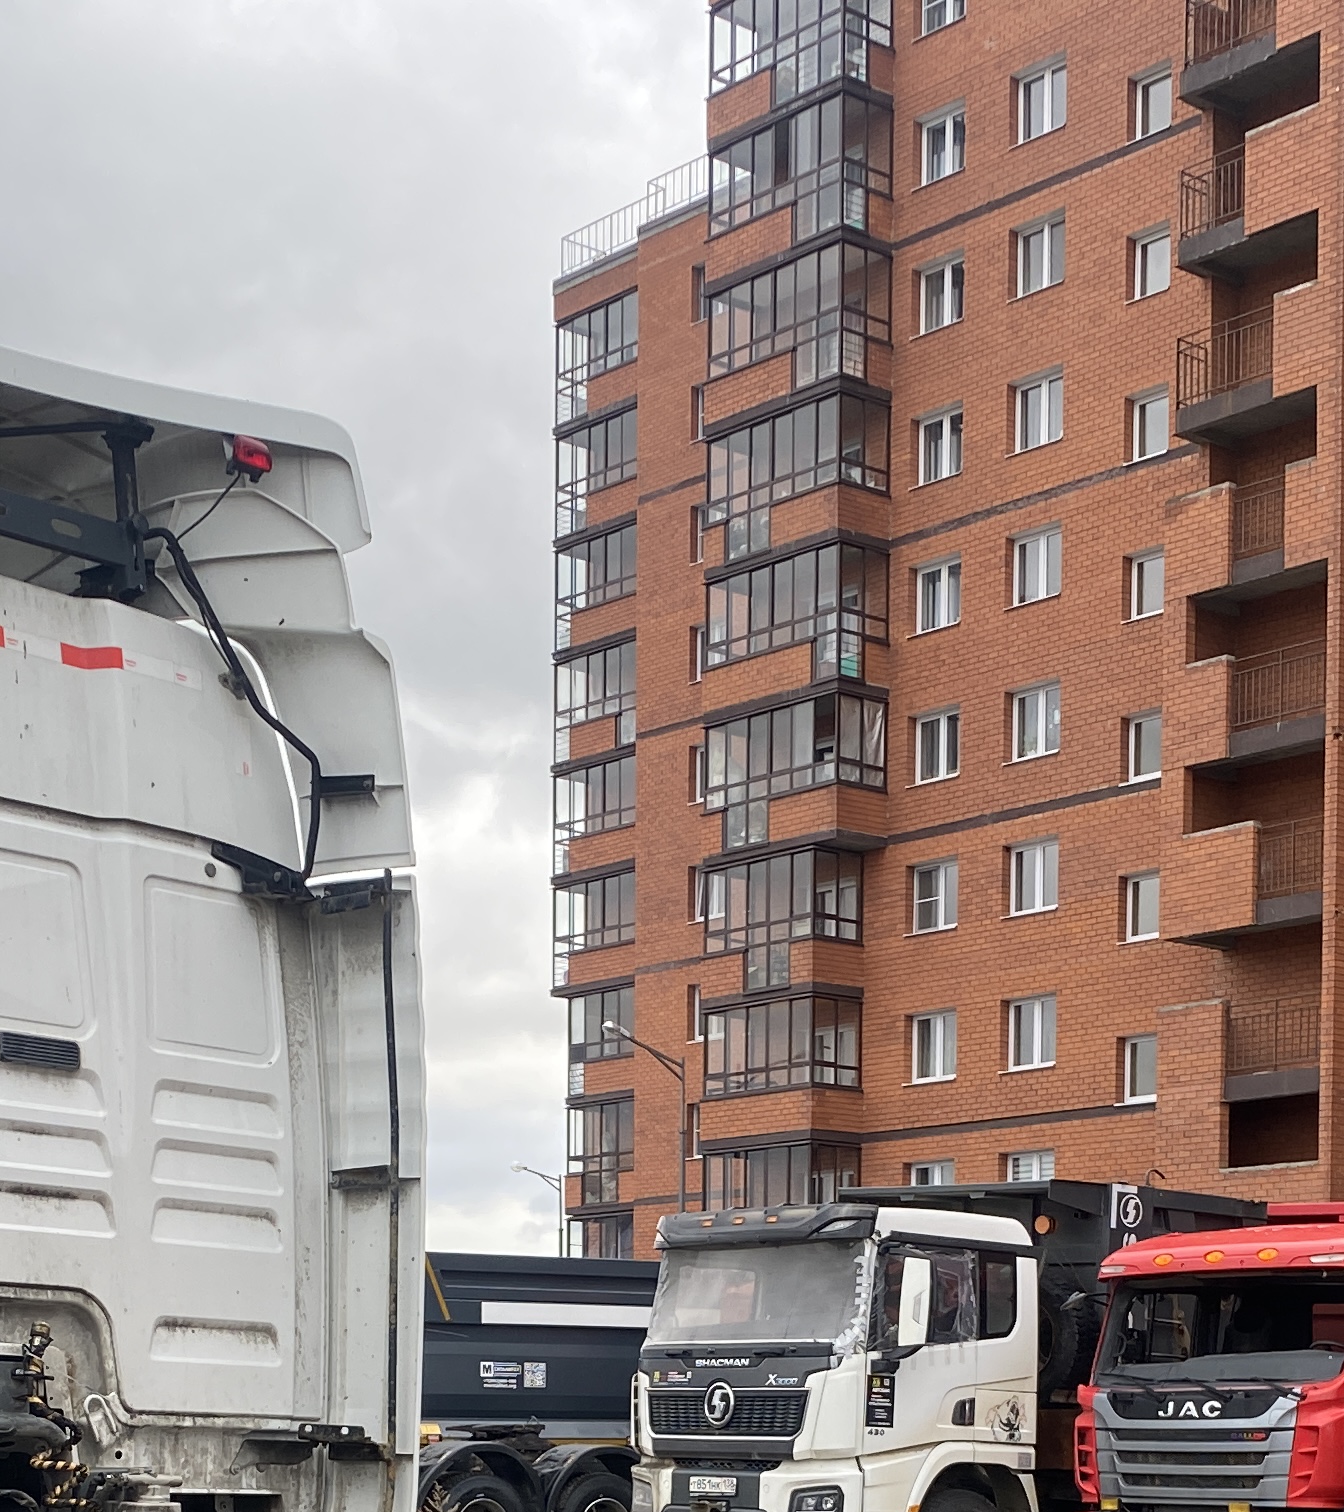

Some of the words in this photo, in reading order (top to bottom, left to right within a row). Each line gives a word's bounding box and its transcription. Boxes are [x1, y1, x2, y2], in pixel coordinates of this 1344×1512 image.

[695, 1358, 750, 1367] SHACMAN
[1158, 1401, 1222, 1418] JAC
[867, 1428, 885, 1436] 430
